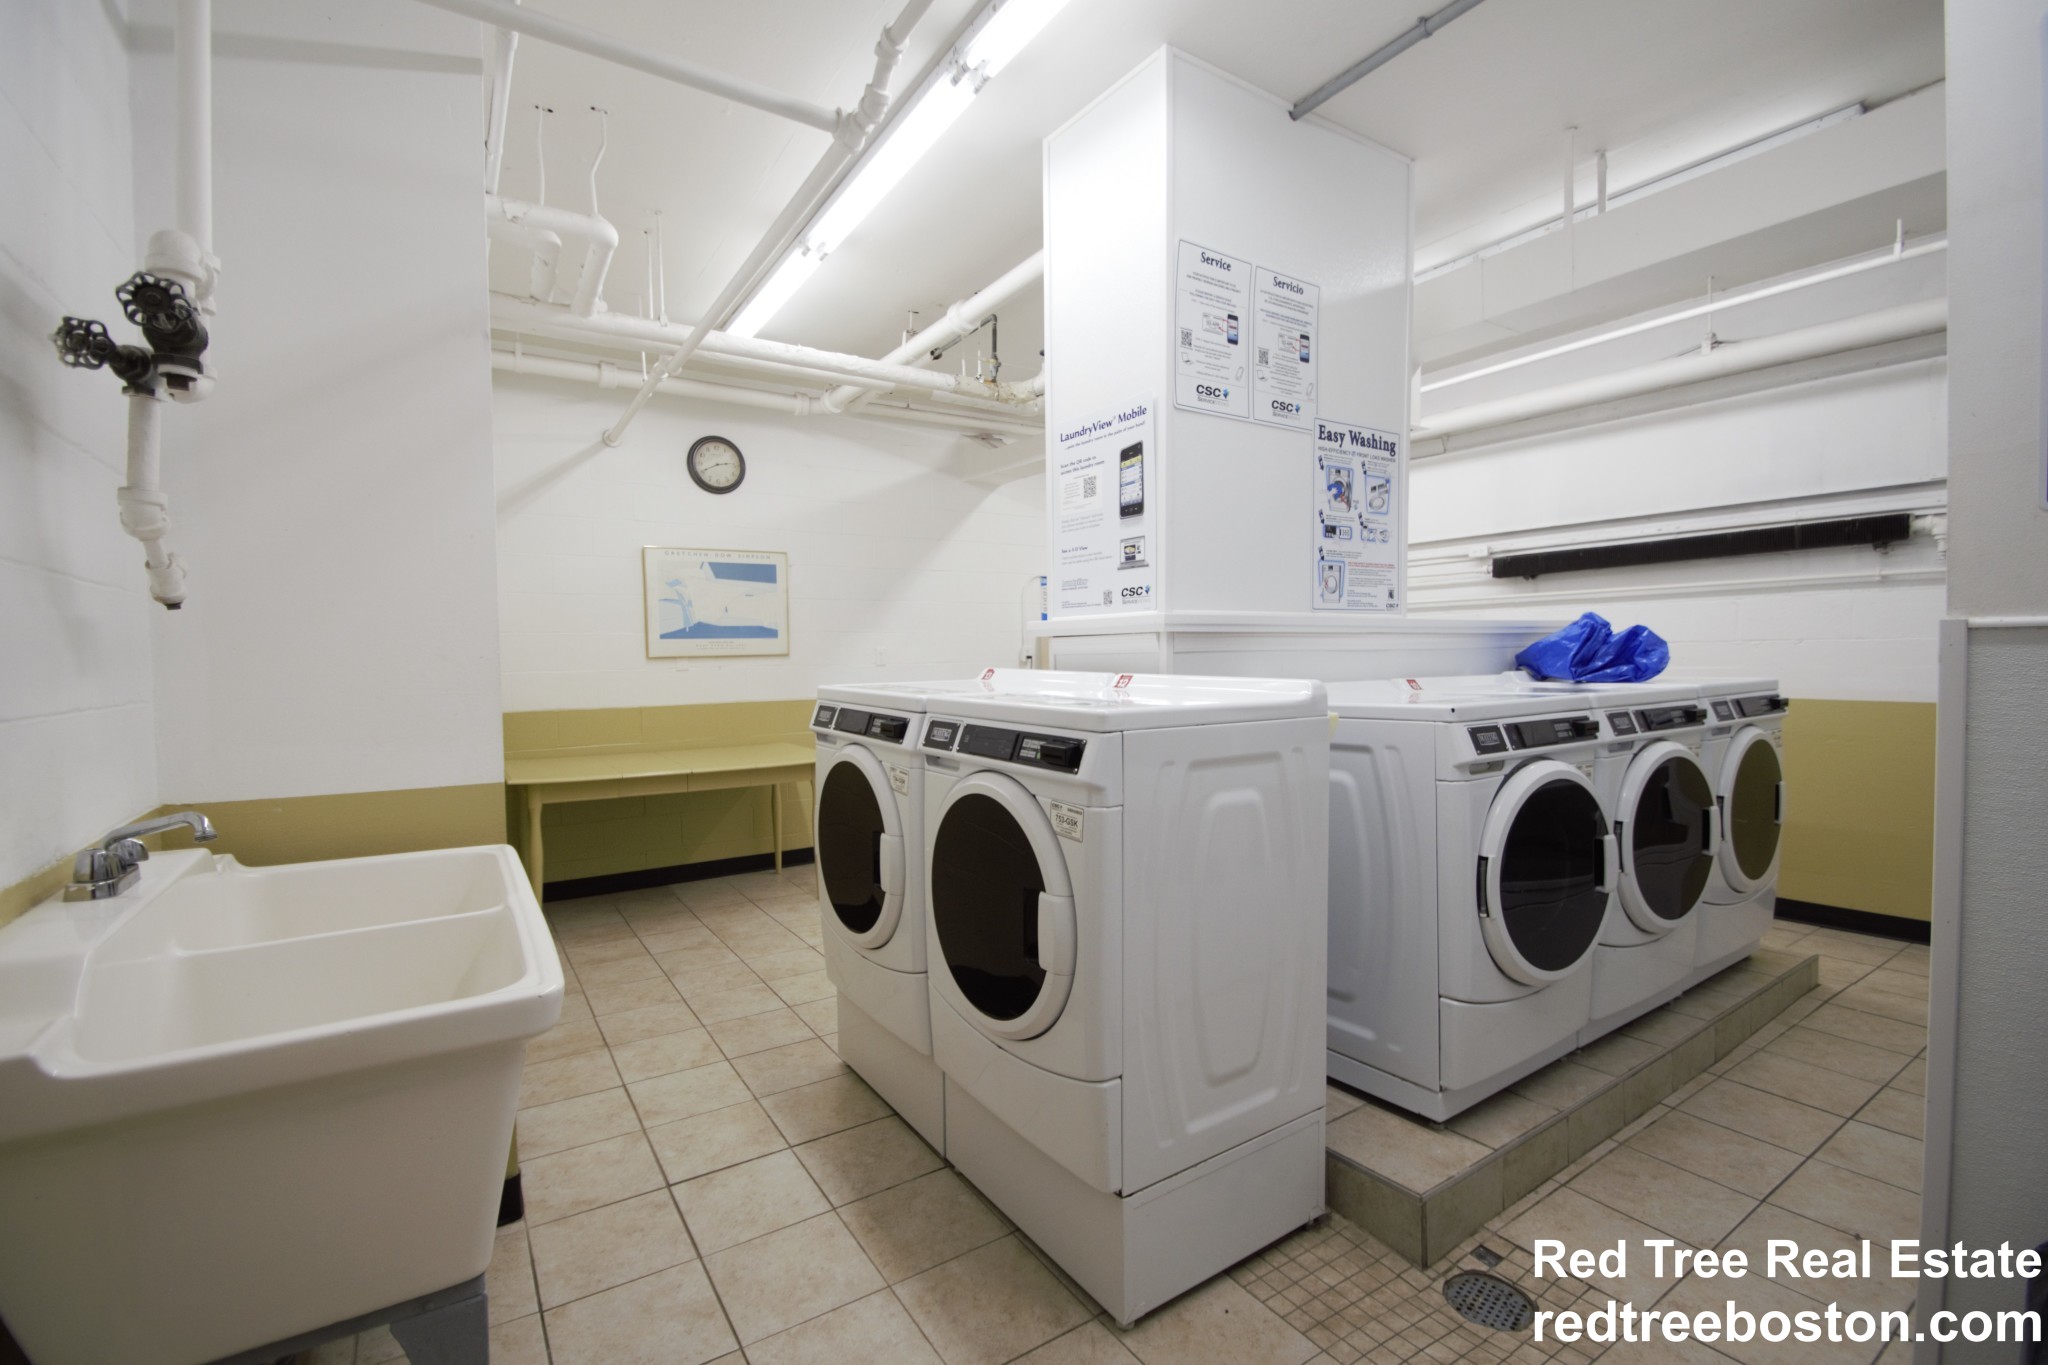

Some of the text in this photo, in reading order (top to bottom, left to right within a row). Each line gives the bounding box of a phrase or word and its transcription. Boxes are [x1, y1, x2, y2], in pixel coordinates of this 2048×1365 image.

[1200, 252, 1232, 272] Service
[1273, 276, 1304, 295] Servicio
[1196, 384, 1221, 398] CSC
[1118, 405, 1147, 424] Mobile
[1272, 400, 1294, 412] CSC
[1318, 424, 1396, 457] Easy Washing
[1121, 586, 1143, 597] CSC
